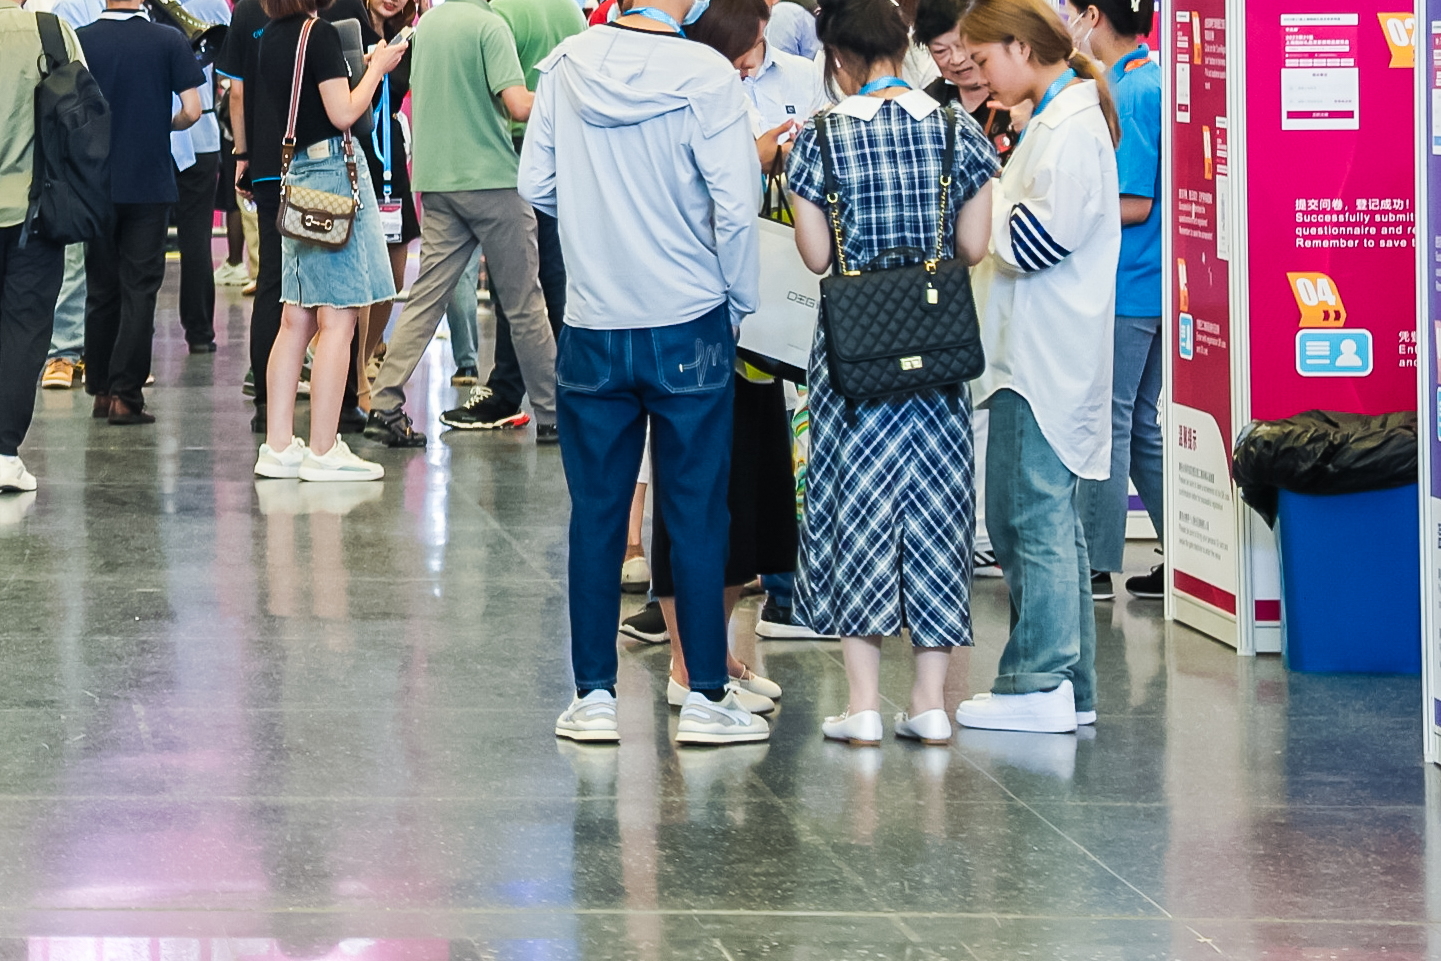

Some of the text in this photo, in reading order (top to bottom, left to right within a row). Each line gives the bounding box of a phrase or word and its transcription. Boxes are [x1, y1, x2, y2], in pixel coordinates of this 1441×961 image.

[1295, 212, 1370, 224] Successfully
[1295, 225, 1377, 237] questionnaire
[1381, 225, 1403, 235] and
[1295, 238, 1359, 248] Remember
[1364, 238, 1375, 248] to
[1380, 239, 1407, 248] save
[1295, 277, 1336, 307] 04
